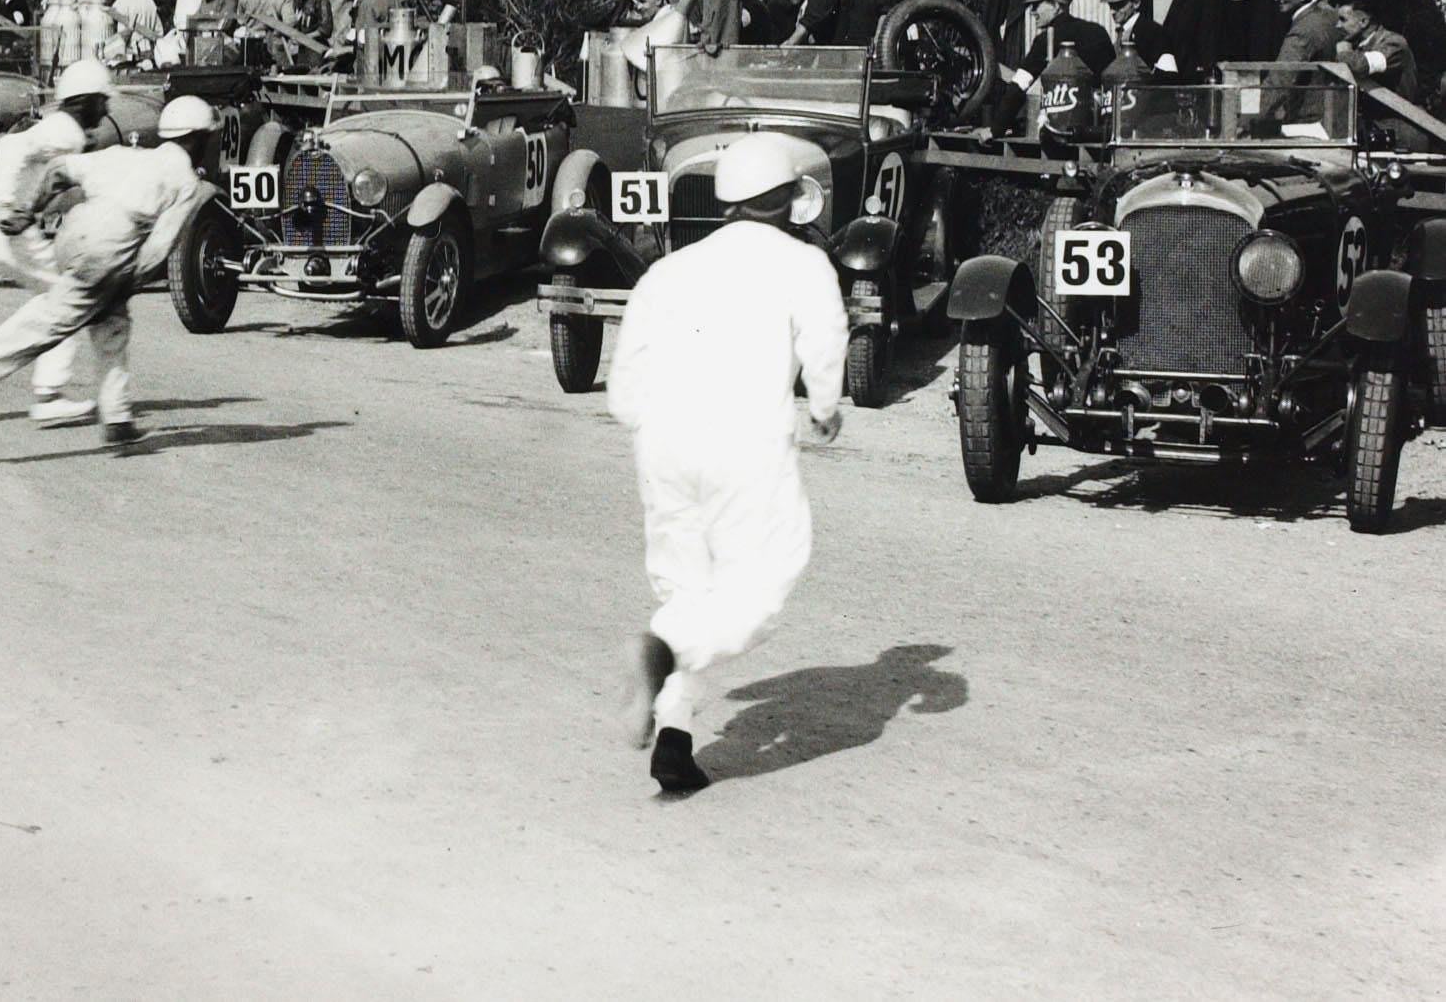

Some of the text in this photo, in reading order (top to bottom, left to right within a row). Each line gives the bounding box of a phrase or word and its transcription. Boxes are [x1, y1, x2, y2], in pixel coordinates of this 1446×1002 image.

[221, 115, 239, 160] 49
[526, 138, 545, 190] 50
[233, 172, 275, 203] 50
[620, 179, 662, 215] 51
[1061, 239, 1125, 286] 53
